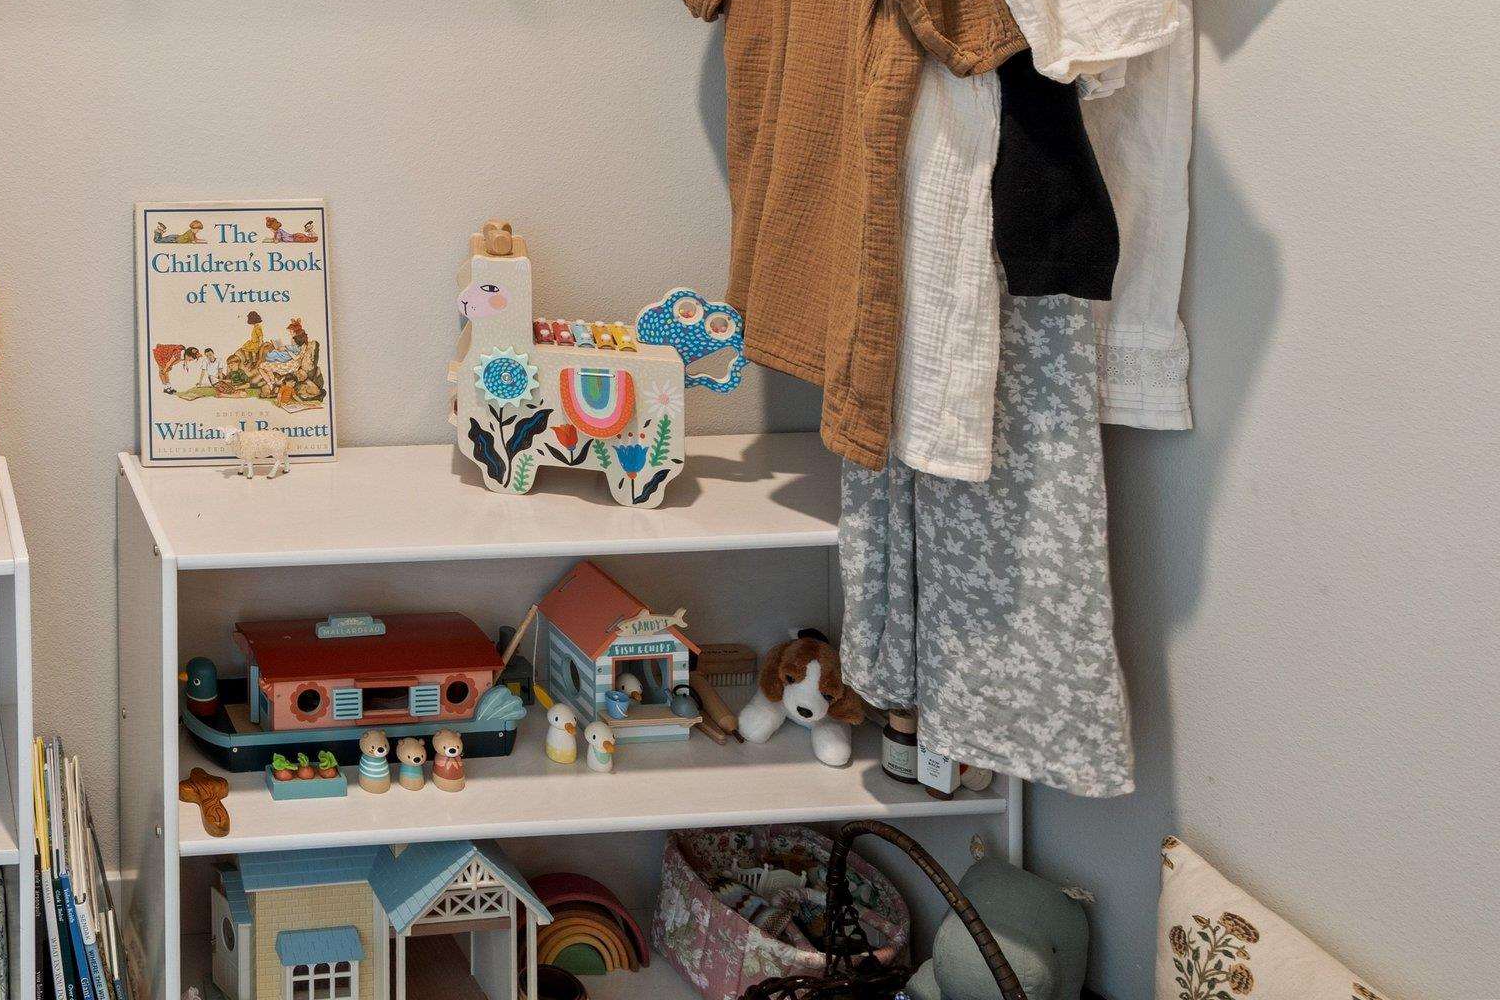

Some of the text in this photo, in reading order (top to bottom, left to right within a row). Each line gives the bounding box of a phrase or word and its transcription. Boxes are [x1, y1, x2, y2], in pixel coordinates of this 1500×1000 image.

[215, 223, 258, 245] The
[151, 252, 323, 274] Children's Book
[186, 283, 291, 304] of Virtues
[632, 619, 668, 635] SANDY'S
[614, 645, 634, 655] FISH
[644, 643, 670, 653] CHIPS
[79, 914, 91, 942] SENDAK
[88, 949, 100, 975] WHERE
[94, 976, 102, 989] THE
[80, 976, 90, 999] Giant
